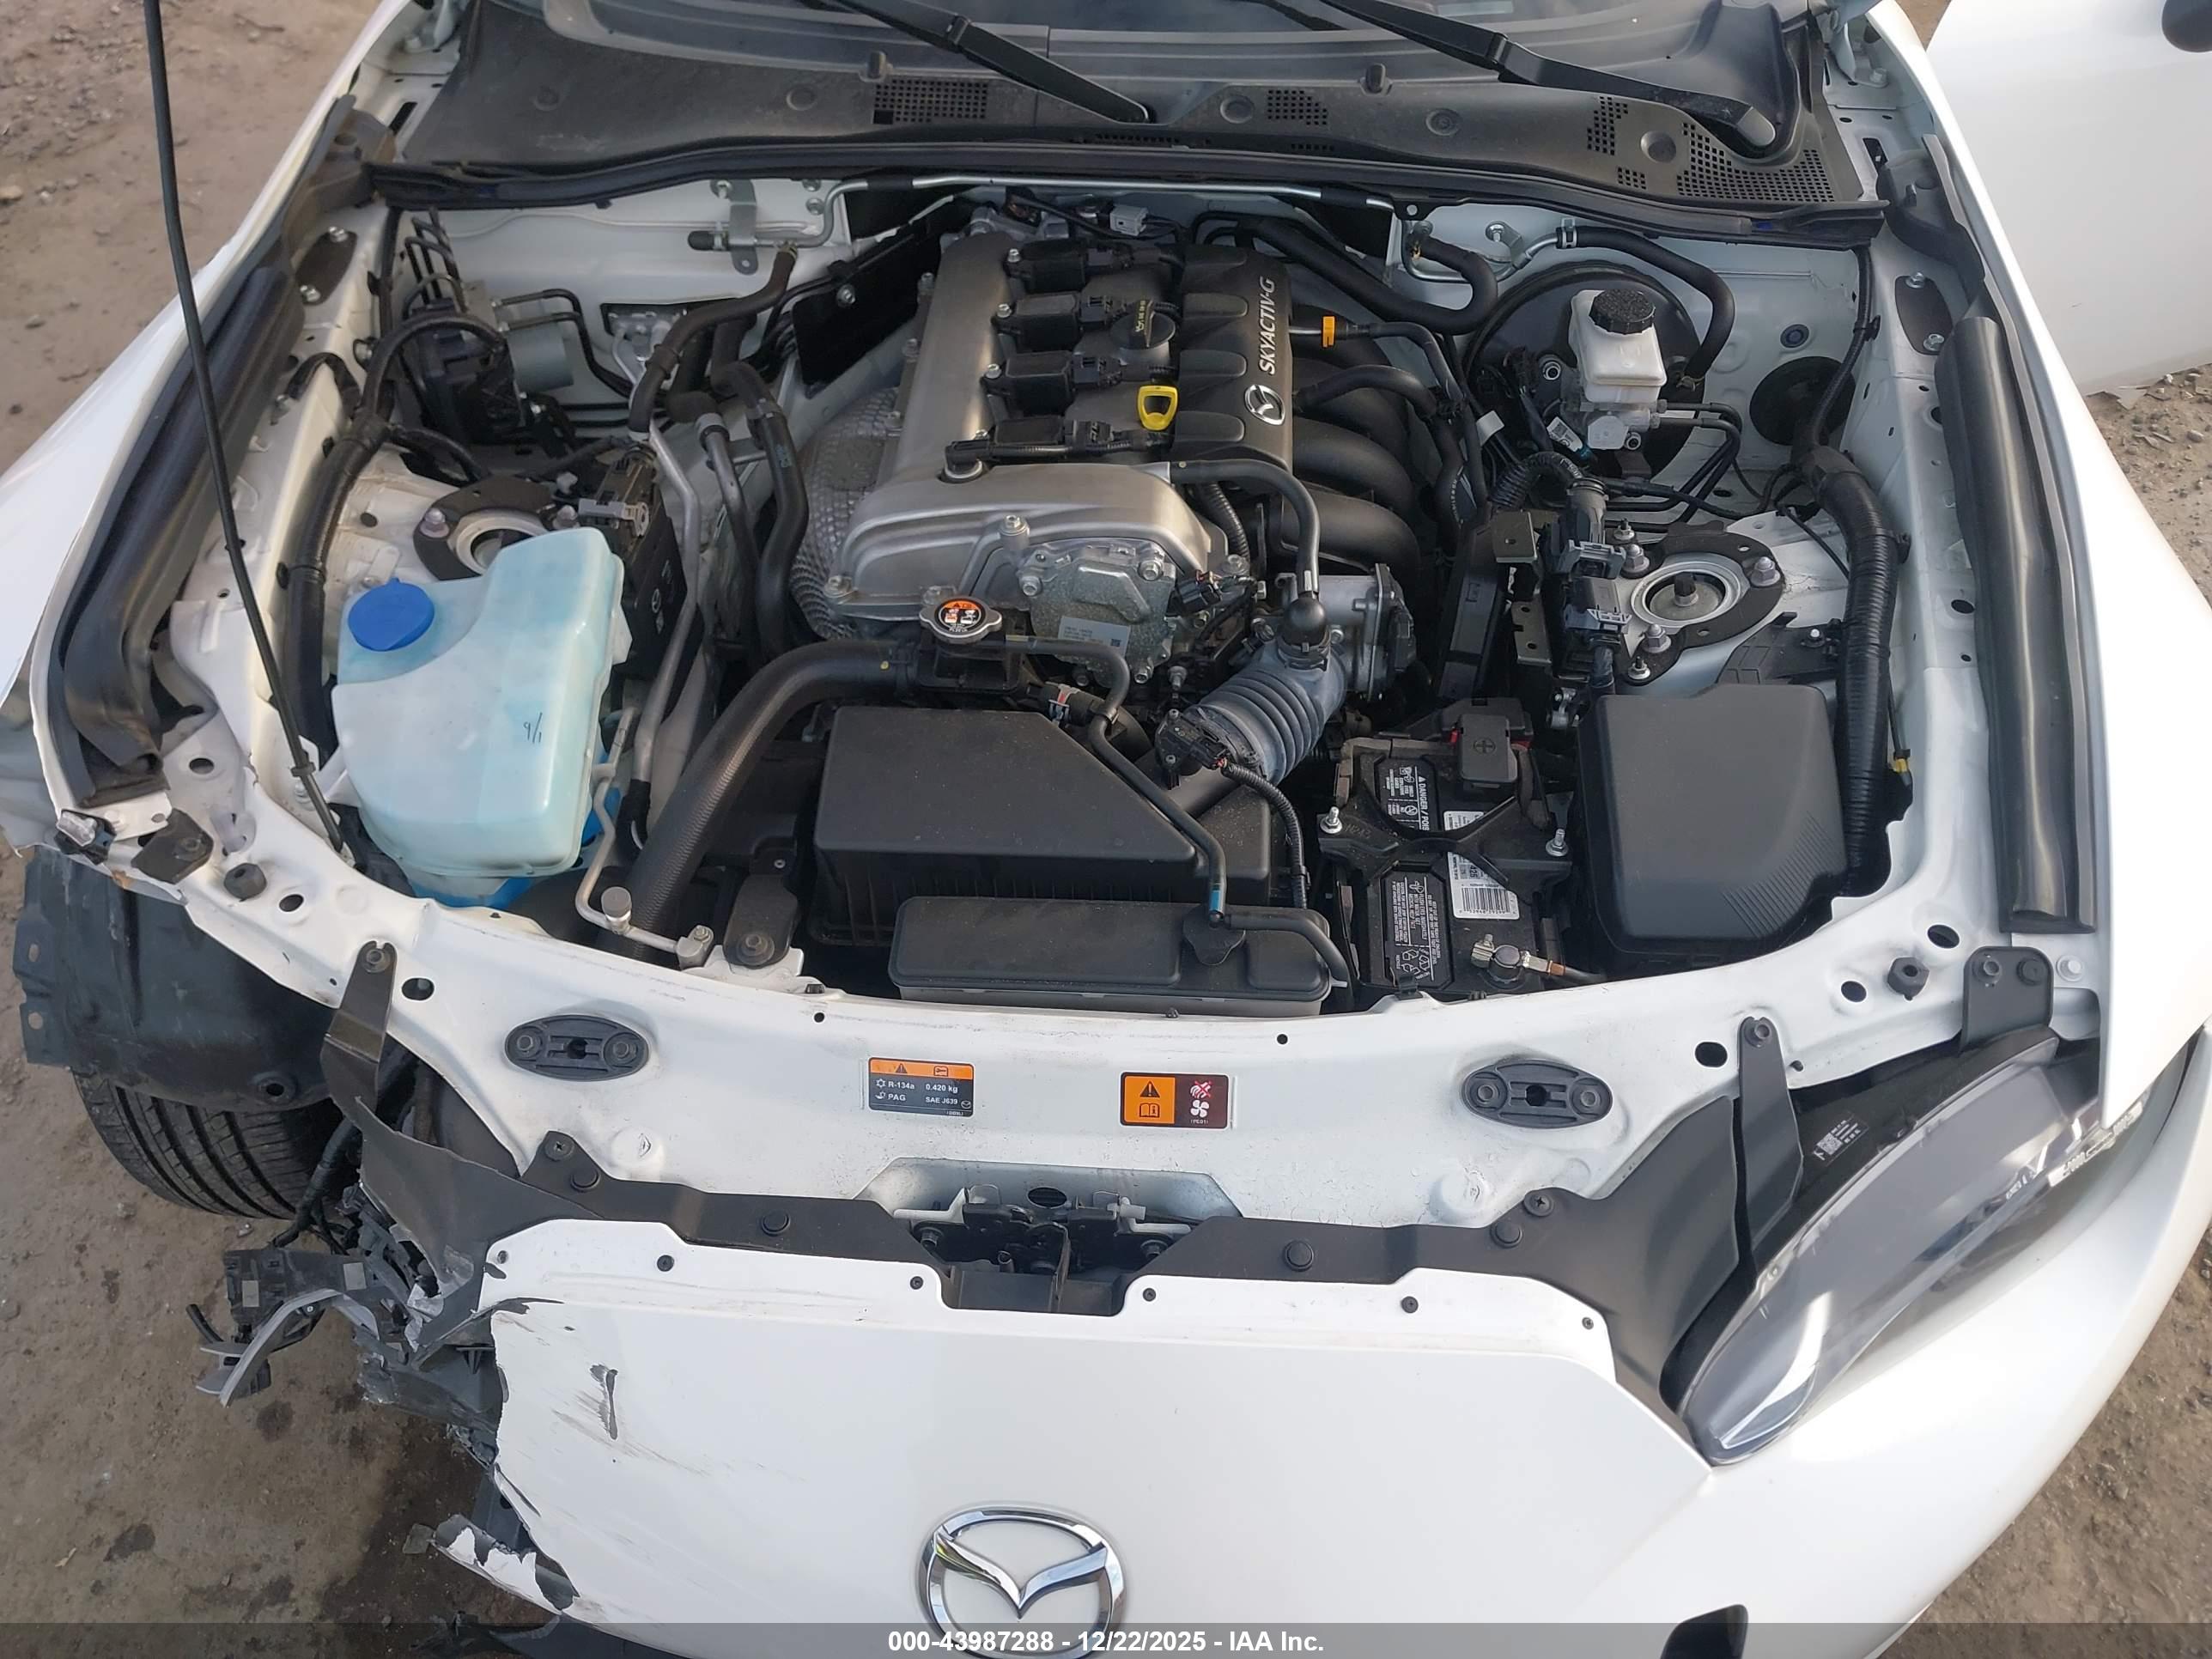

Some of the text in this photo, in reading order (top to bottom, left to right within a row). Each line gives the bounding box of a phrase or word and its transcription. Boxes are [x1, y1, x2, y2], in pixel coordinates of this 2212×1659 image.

[1259, 276, 1276, 375] SKYACTIV-G
[1419, 783, 1428, 810] DANGER
[1421, 816, 1430, 830] POIS
[888, 1080, 958, 1094] R-134a 0.420 kg
